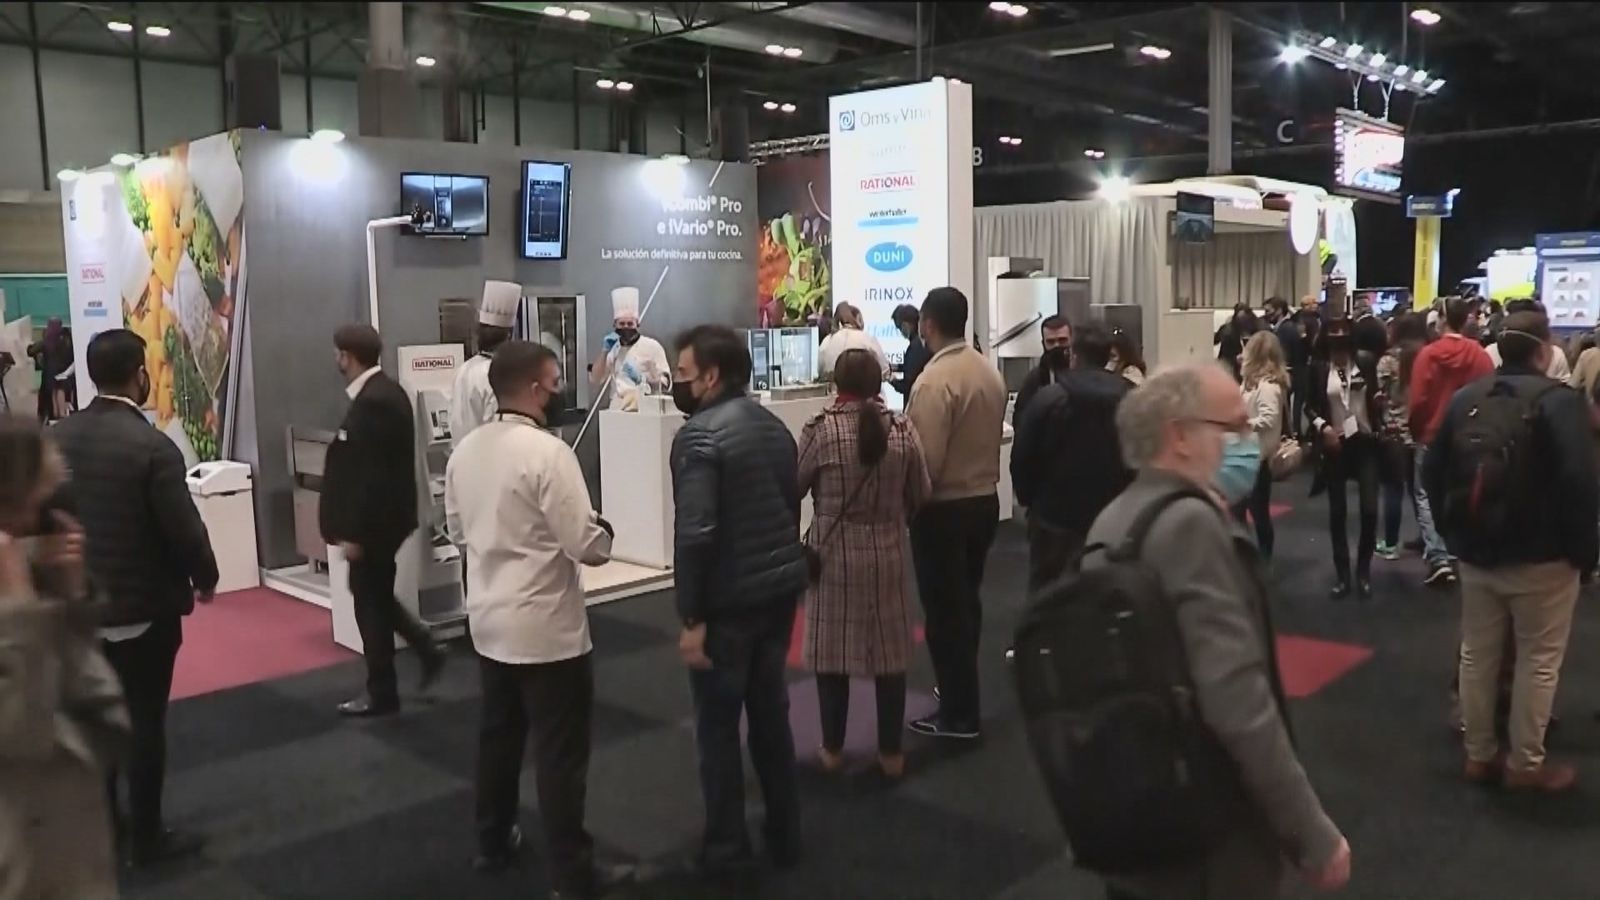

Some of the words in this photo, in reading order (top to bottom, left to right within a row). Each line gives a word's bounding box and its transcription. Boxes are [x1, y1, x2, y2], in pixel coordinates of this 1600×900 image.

[860, 111, 890, 127] Oms
[1277, 119, 1294, 143] C
[972, 146, 983, 166] B
[860, 175, 915, 190] RATIONAL
[720, 196, 742, 212] Pro
[657, 221, 666, 235] e
[717, 220, 742, 236] Pro.
[601, 248, 612, 259] La
[613, 248, 649, 260] solución
[650, 248, 688, 260] definitiva
[689, 250, 707, 262] para
[707, 249, 716, 260] tu
[873, 251, 905, 264] DUNI
[864, 287, 914, 301] IRINOX
[414, 359, 452, 368] RATIONAL
